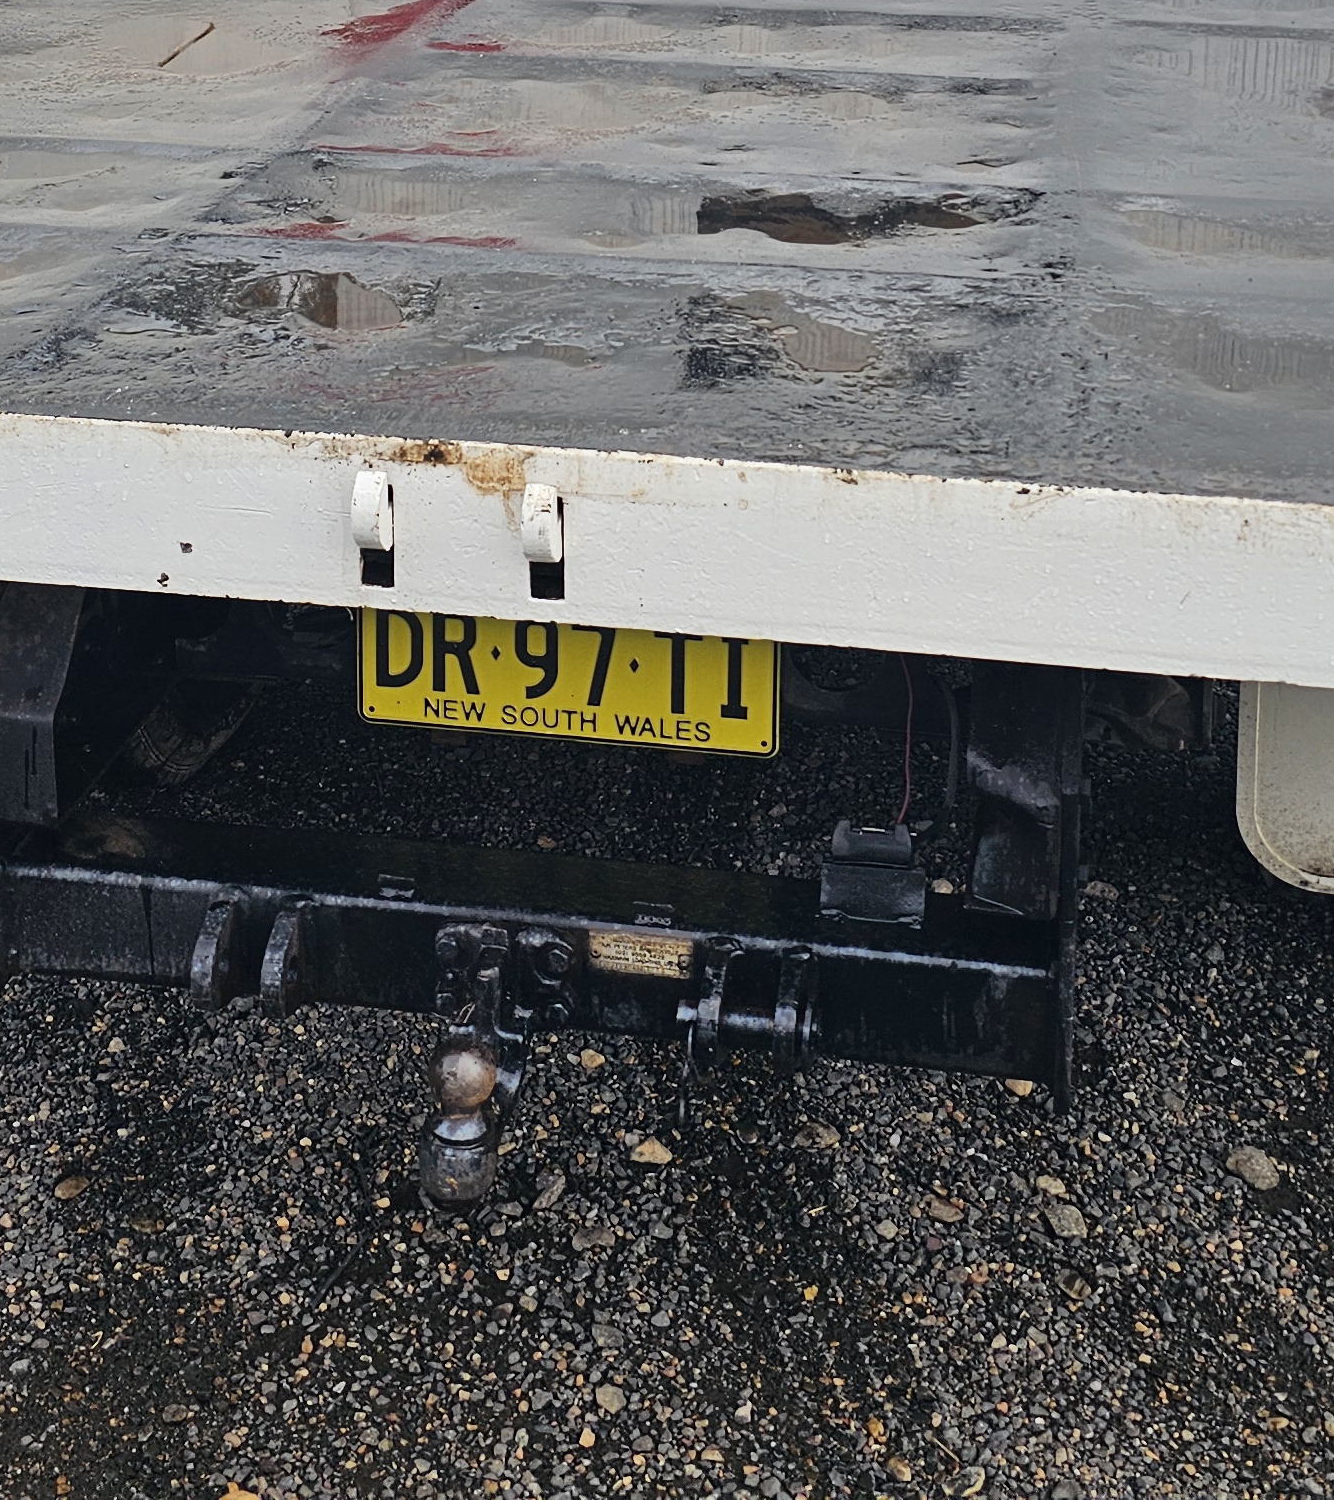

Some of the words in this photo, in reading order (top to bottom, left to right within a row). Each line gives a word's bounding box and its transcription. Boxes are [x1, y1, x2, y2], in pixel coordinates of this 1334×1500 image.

[424, 697, 486, 722] NEW
[501, 705, 598, 733] SOUTH
[614, 714, 711, 741] WALES
